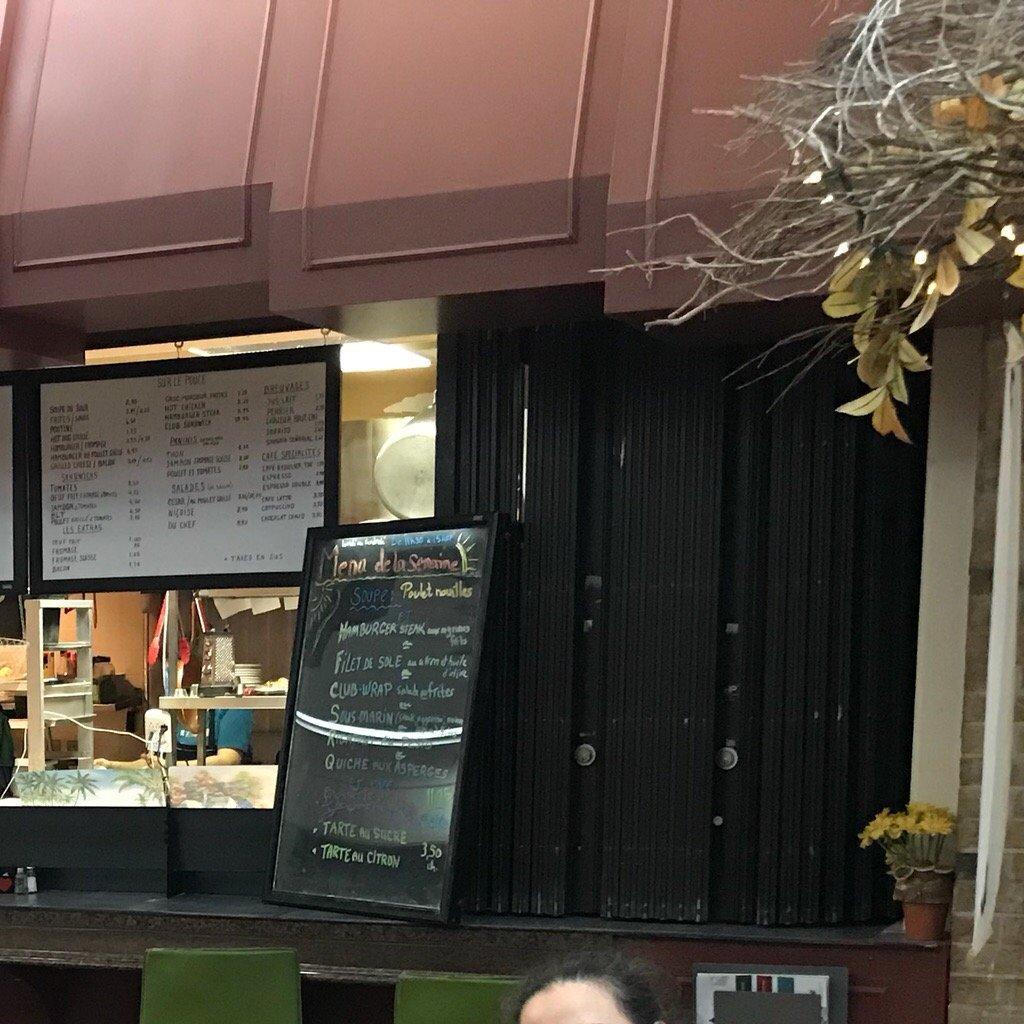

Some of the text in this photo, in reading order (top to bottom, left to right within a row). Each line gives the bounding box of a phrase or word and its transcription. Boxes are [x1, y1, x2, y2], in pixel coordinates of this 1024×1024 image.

[374, 547, 391, 573] de
[400, 581, 433, 599] Poulet
[378, 655, 403, 669] SOLE
[325, 754, 369, 771] QUICHE
[393, 761, 449, 779] ASPERGES
[323, 821, 357, 838] TARTE
[321, 843, 351, 863] TARTE
[352, 852, 363, 864] AU
[367, 851, 400, 869] CITRON
